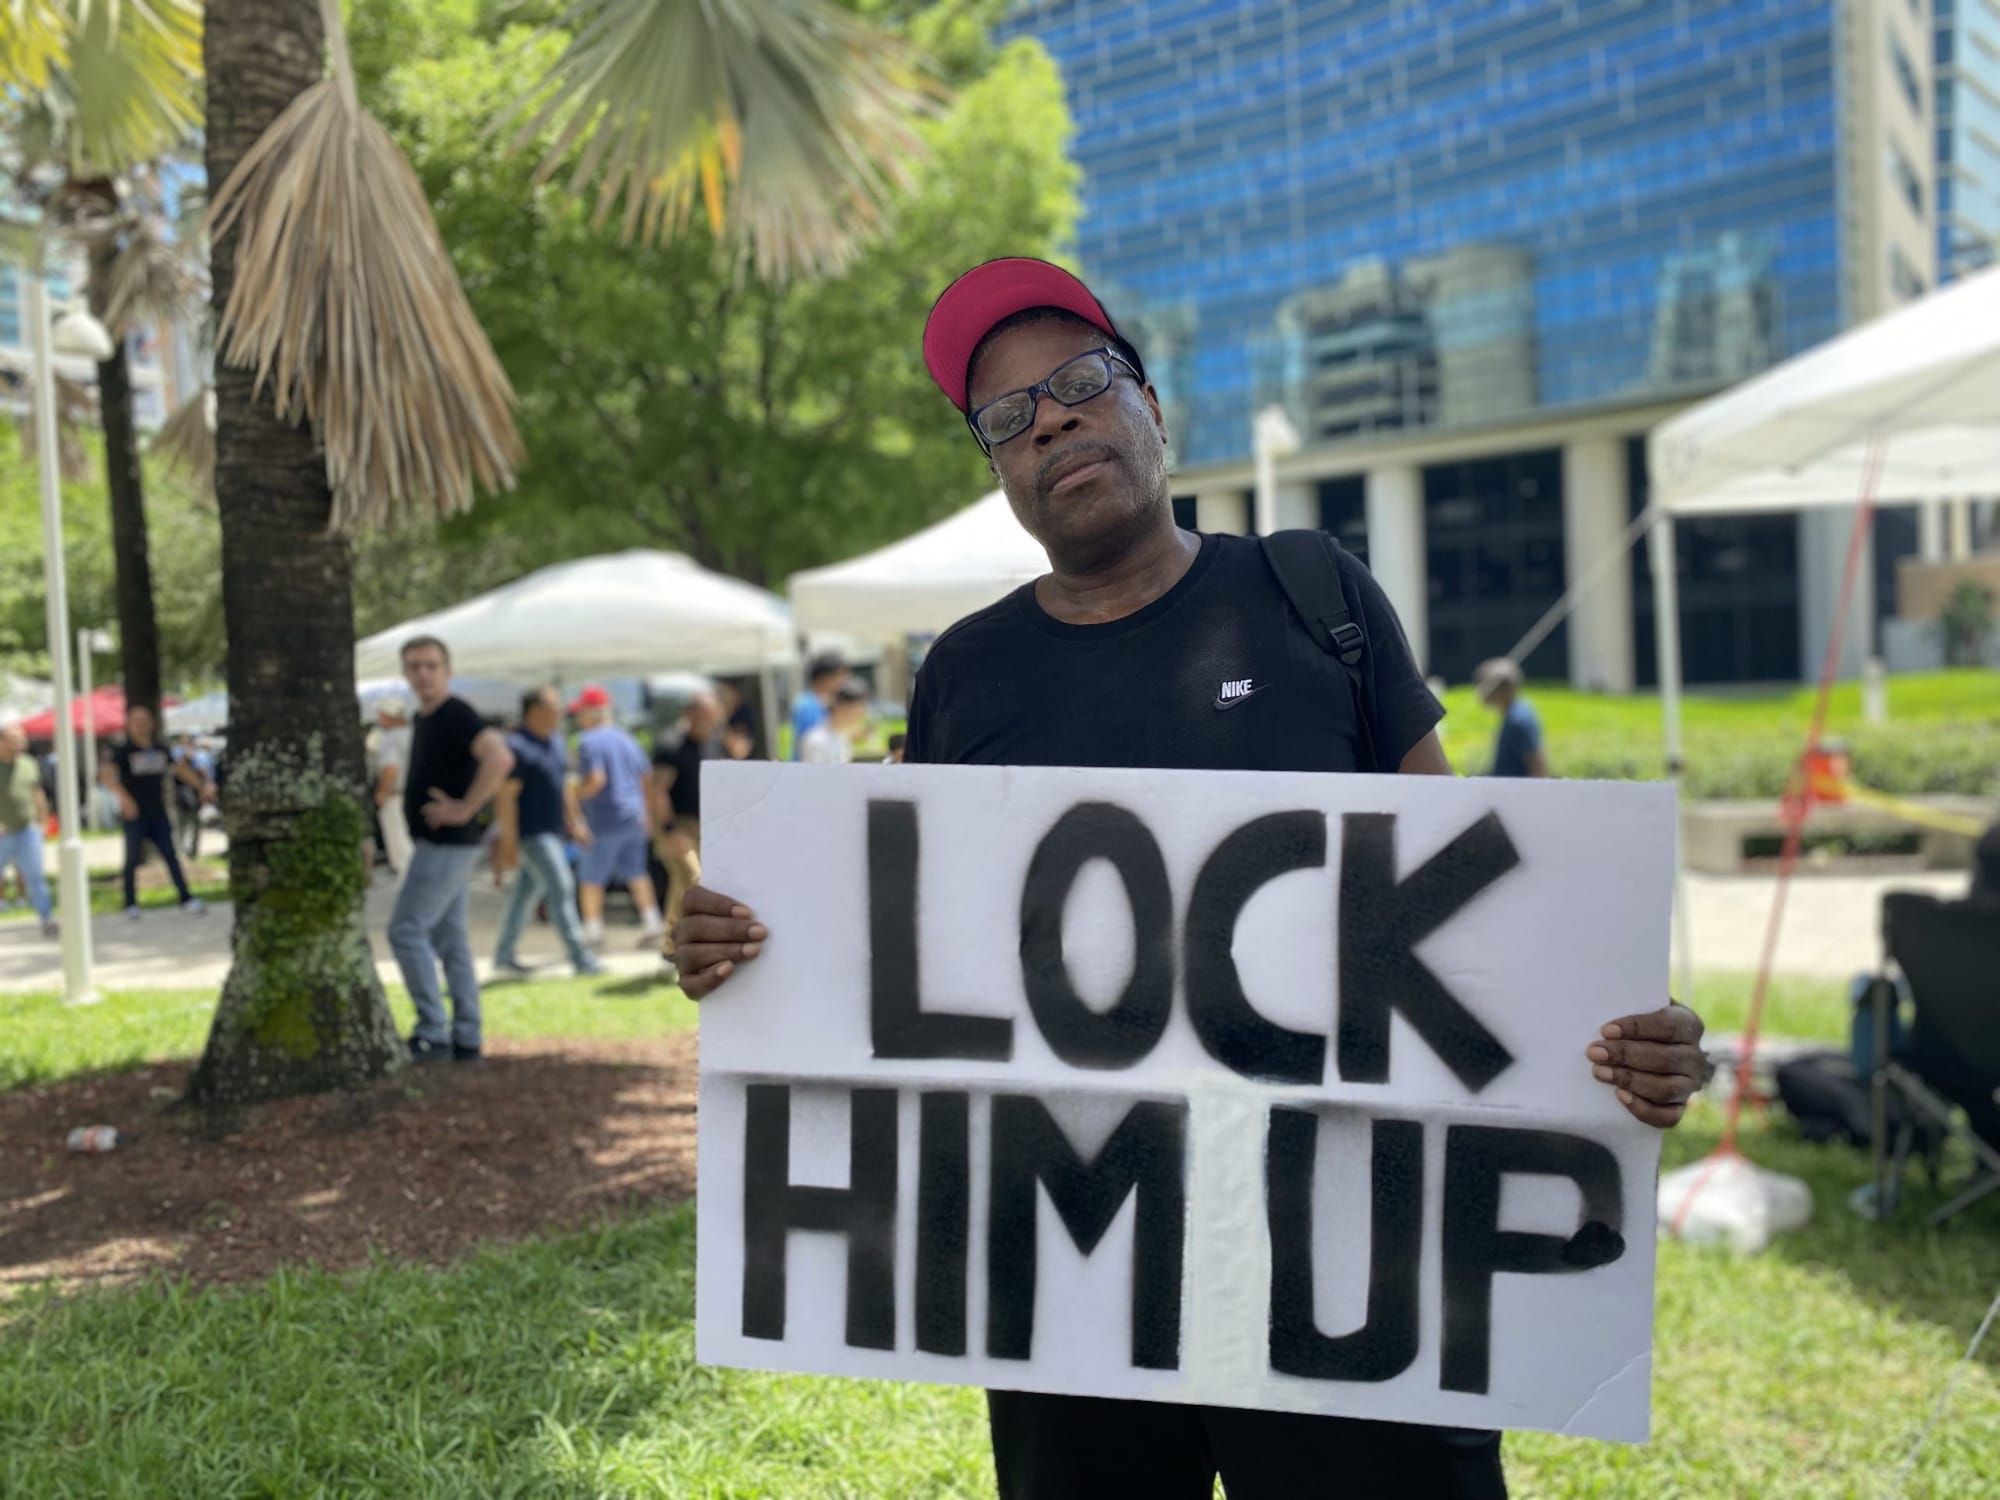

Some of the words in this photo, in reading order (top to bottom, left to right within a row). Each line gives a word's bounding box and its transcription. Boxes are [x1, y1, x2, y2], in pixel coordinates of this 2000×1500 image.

[1221, 678, 1254, 699] NIKE
[867, 800, 1521, 1094] LOCK
[742, 1083, 1189, 1371] HIM
[1266, 1104, 1626, 1395] UP
